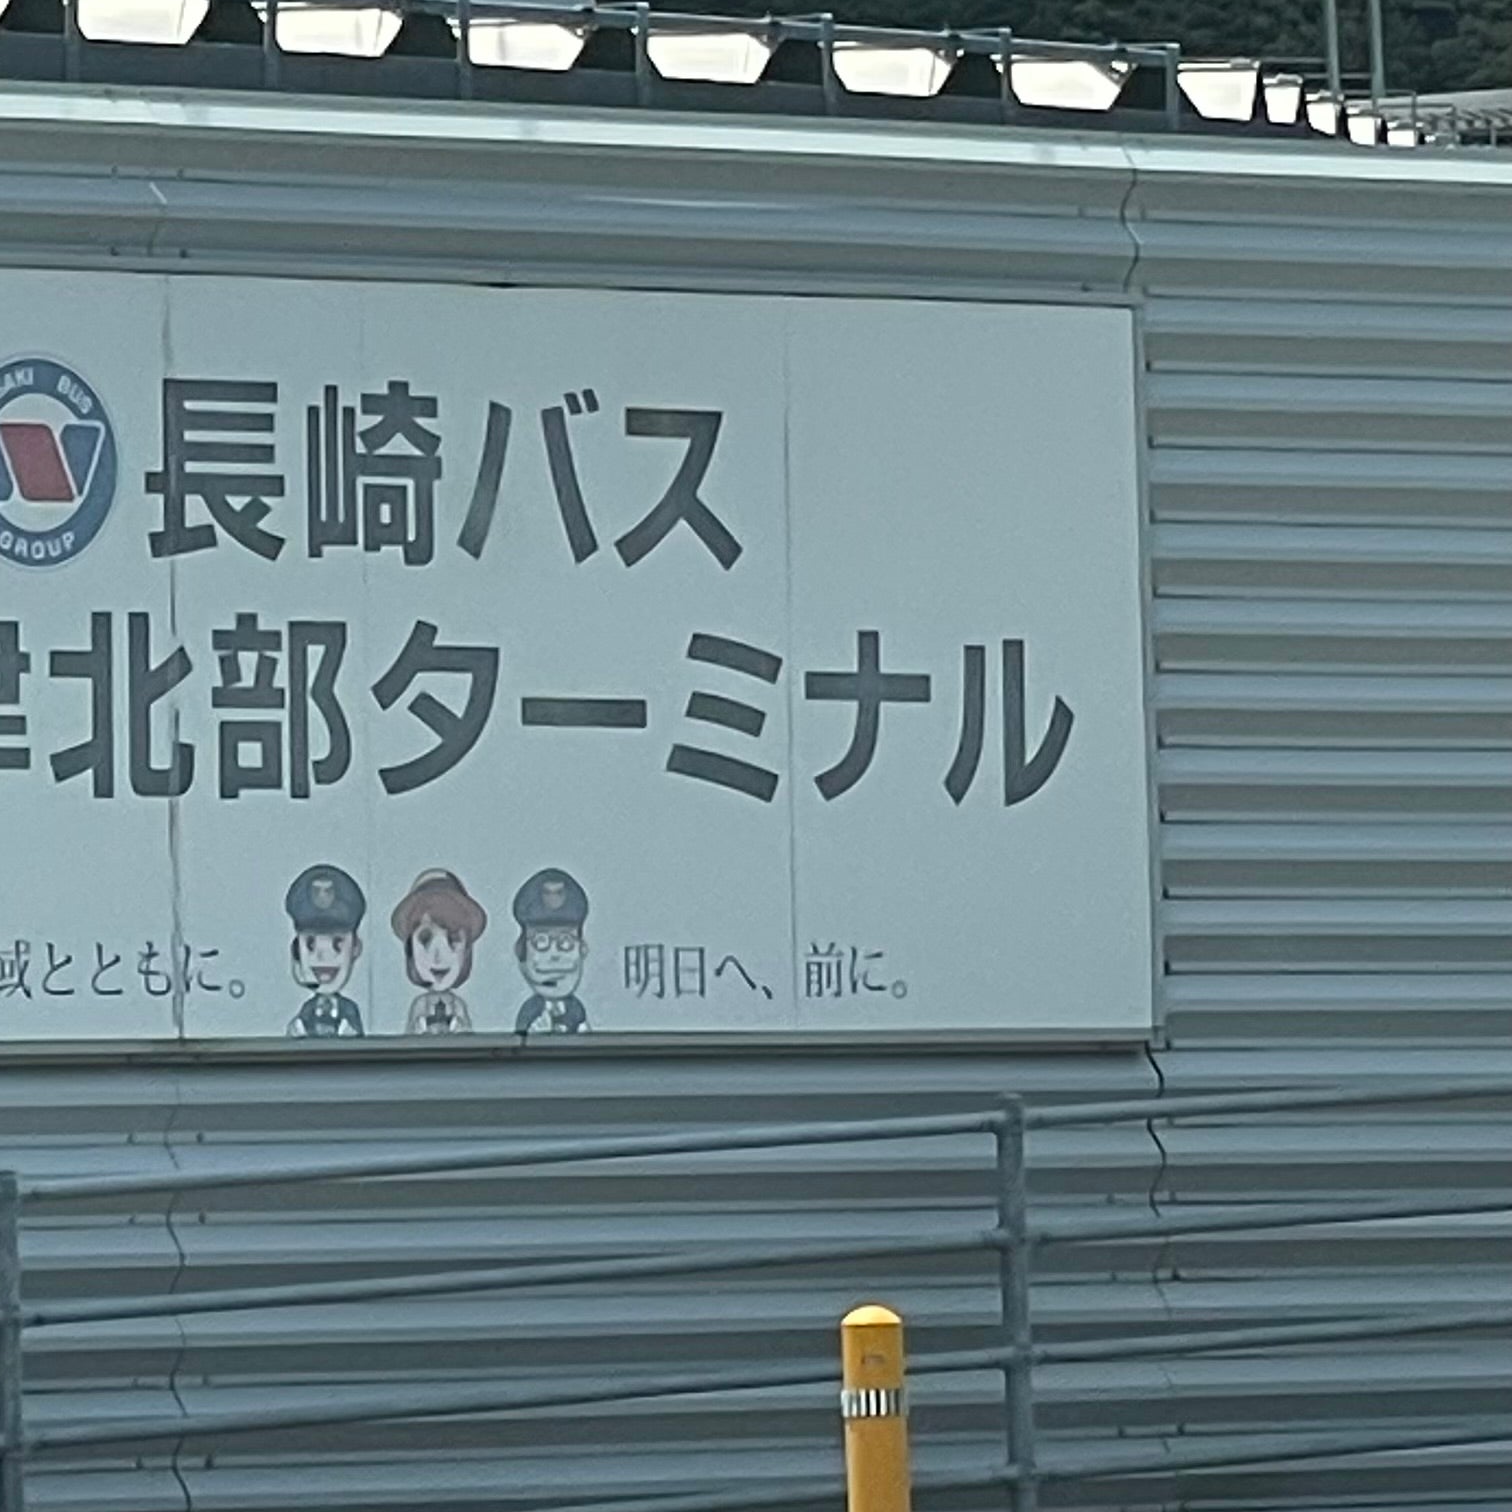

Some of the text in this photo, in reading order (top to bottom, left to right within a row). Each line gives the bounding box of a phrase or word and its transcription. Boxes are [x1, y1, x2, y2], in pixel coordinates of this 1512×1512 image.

[57, 375, 93, 414] BUS
[144, 377, 743, 570] 長崎バス
